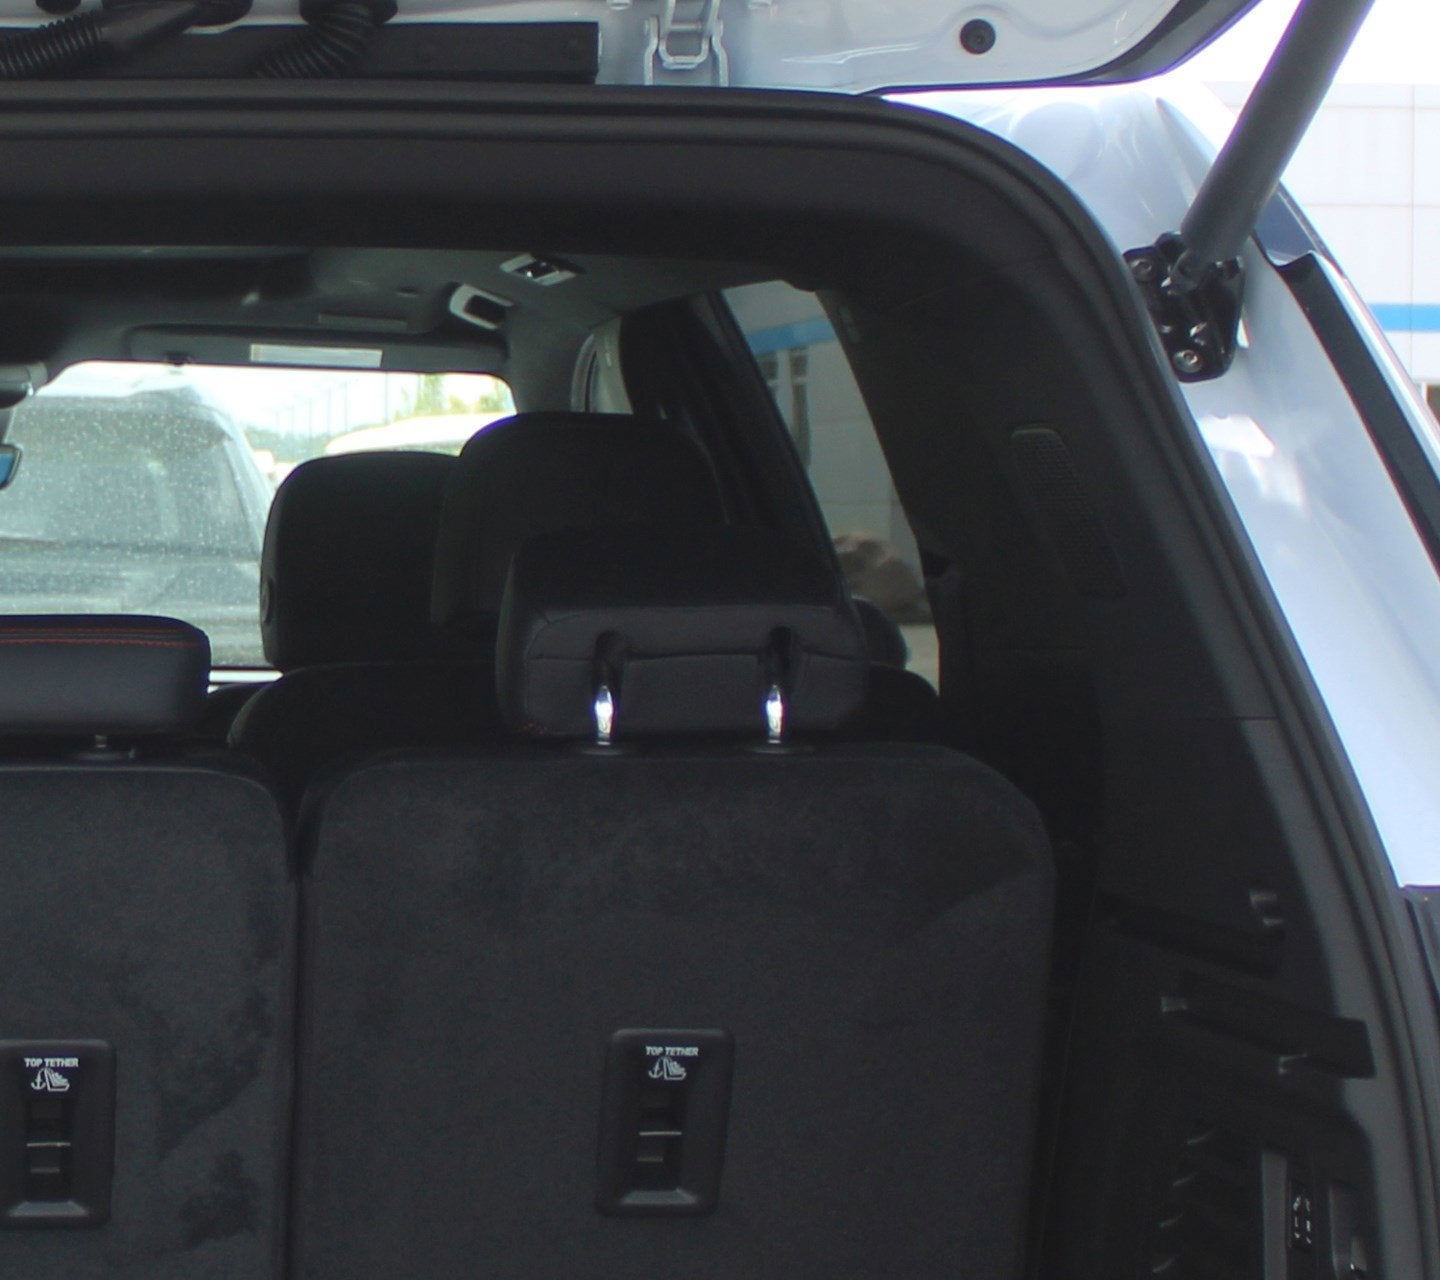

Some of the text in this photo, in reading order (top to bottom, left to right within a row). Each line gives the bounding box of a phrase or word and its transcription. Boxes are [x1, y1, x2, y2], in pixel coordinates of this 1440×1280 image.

[645, 1045, 699, 1056] TOP TETHER
[24, 1057, 79, 1067] TOP TETHER
